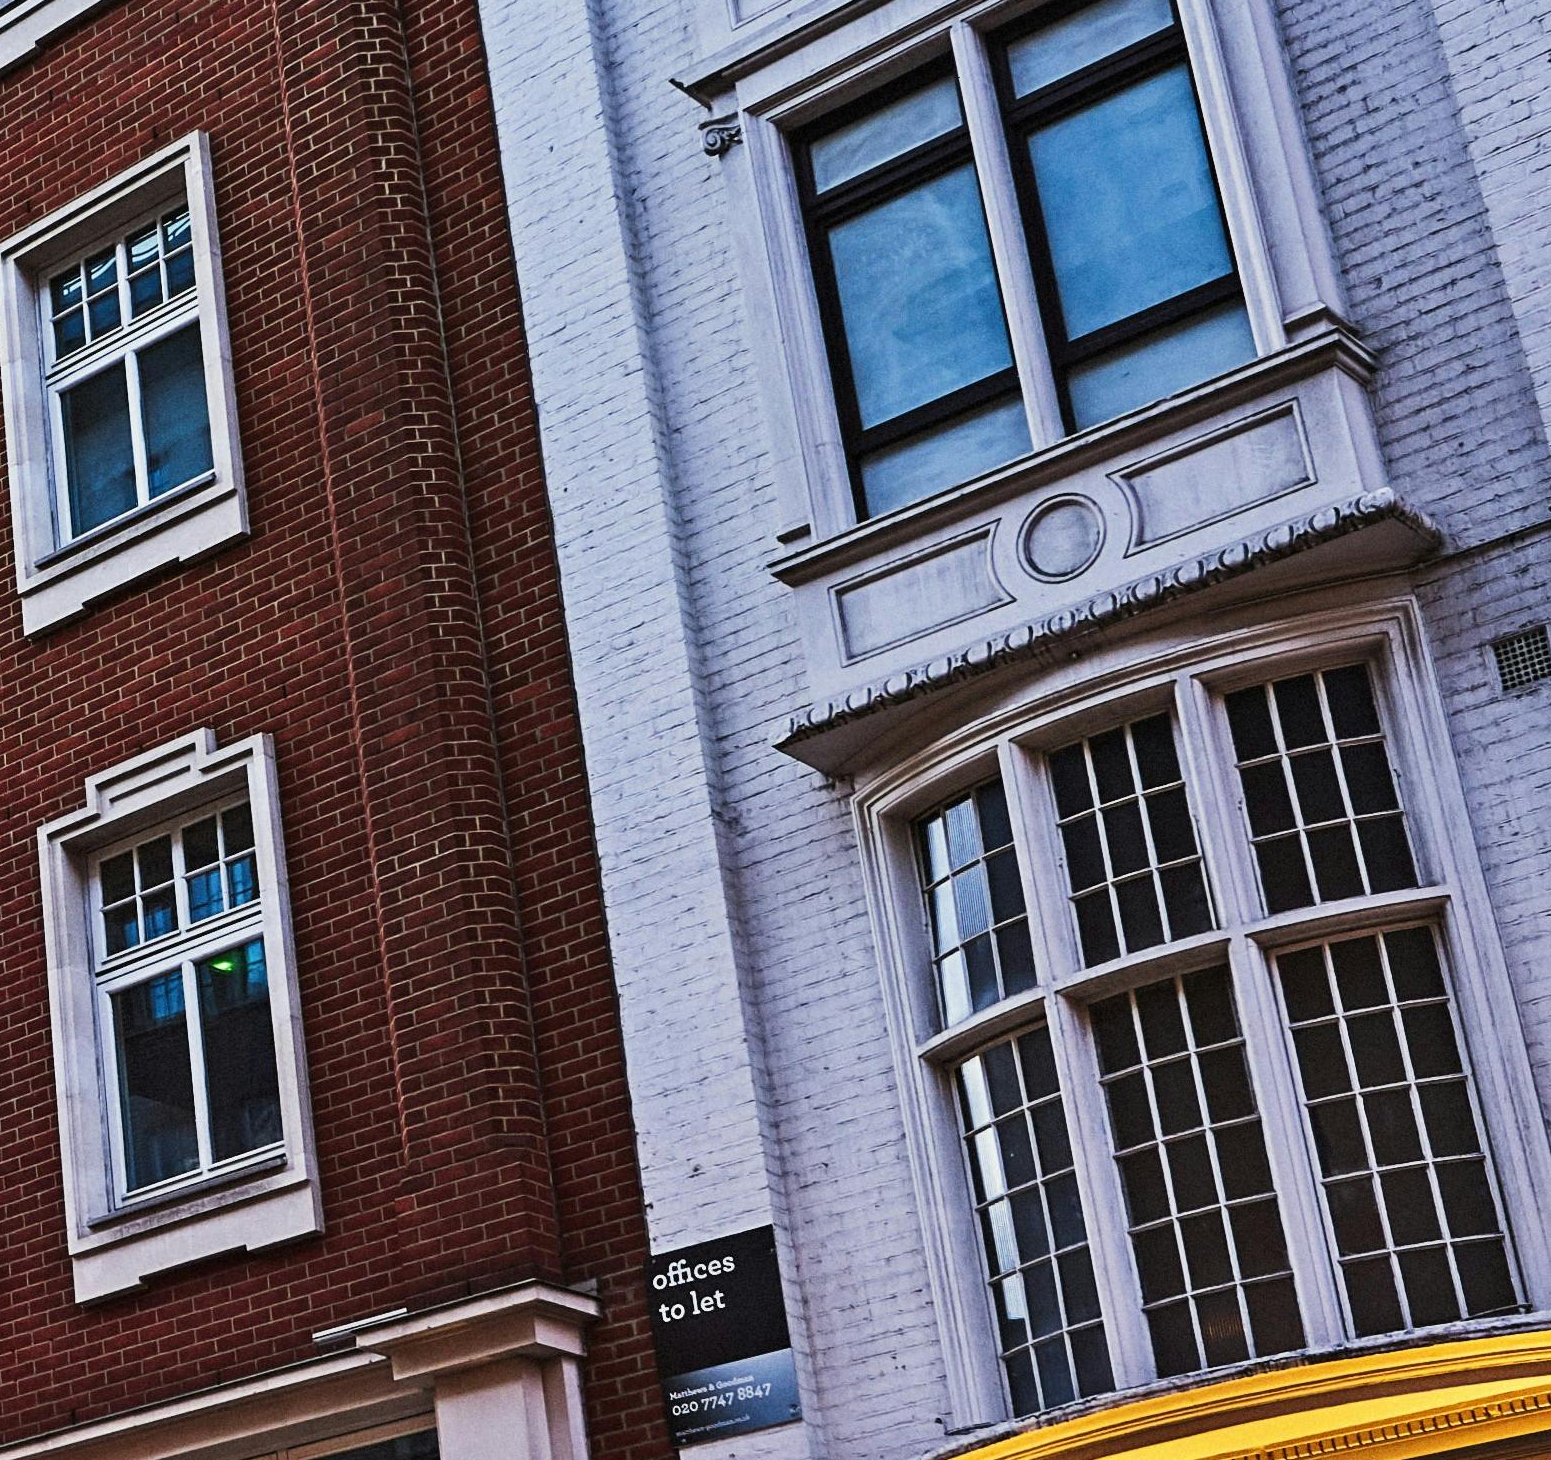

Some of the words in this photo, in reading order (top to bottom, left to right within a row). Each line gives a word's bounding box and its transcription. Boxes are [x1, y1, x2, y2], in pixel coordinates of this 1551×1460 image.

[652, 1255, 736, 1290] offices
[658, 1302, 686, 1323] to
[689, 1289, 726, 1315] let
[672, 1401, 699, 1416] 020
[701, 1392, 735, 1412] 7747
[737, 1383, 772, 1401] 8847
[709, 1383, 716, 1392] &
